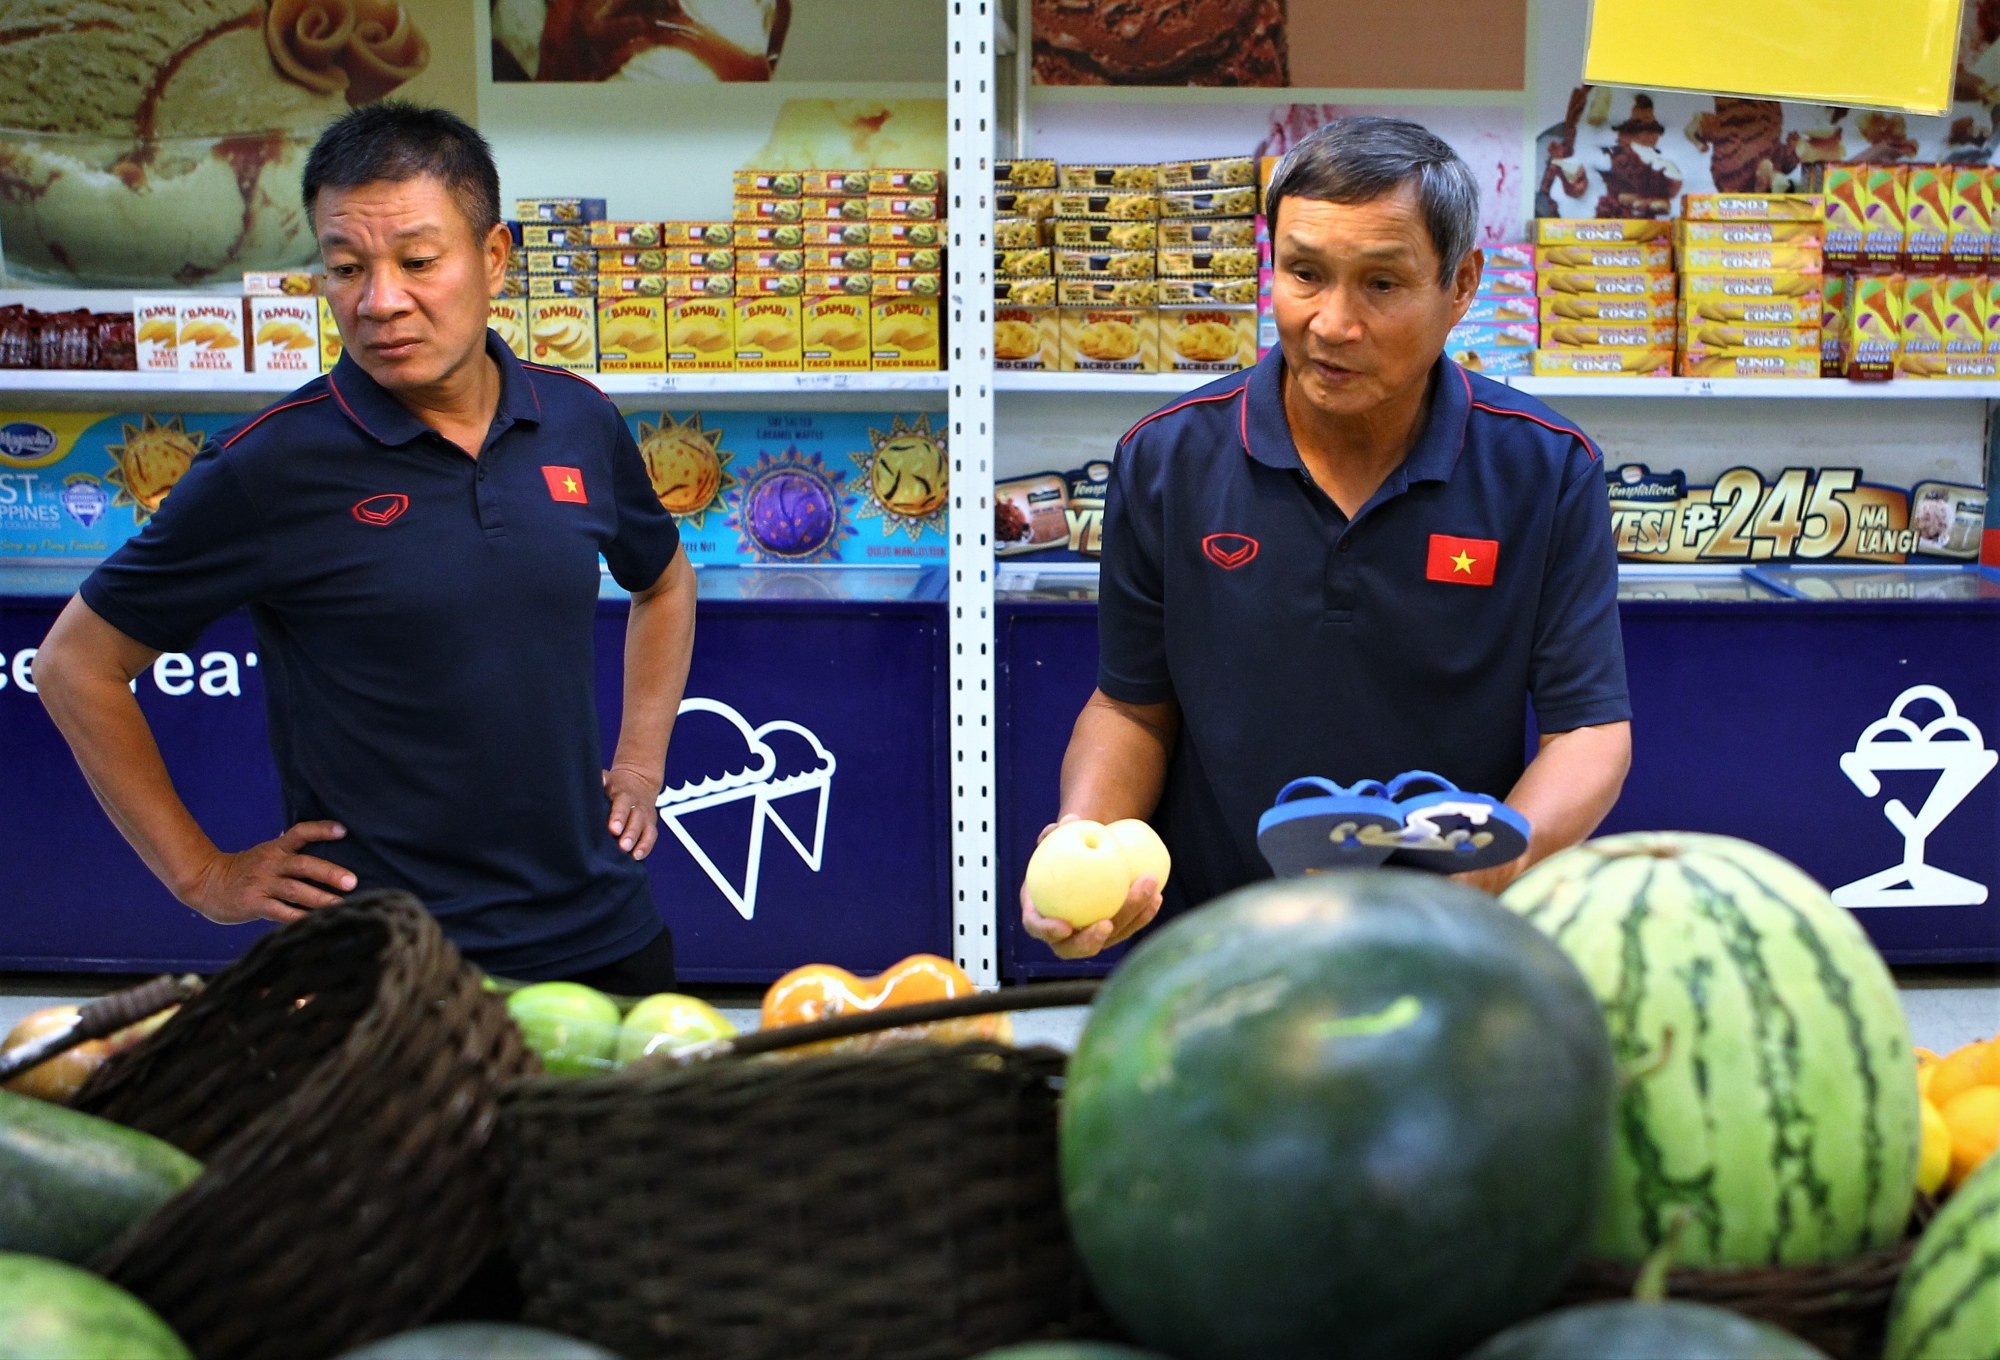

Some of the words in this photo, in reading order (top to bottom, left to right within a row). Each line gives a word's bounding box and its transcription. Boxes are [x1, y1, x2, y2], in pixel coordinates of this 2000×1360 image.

[1576, 229, 1624, 241] CONES
[1723, 231, 1773, 243] CONES
[1591, 255, 1642, 266] CONES
[1722, 257, 1772, 268] CONES
[1595, 282, 1645, 293] CONES
[1723, 284, 1773, 295] CONES
[144, 306, 176, 318] BAM
[187, 306, 230, 319] BAMBI
[263, 306, 305, 319] BAMBI
[490, 306, 515, 320] MBI
[539, 306, 583, 319] BAMBI
[611, 305, 651, 319] BAMBI
[680, 305, 720, 318] BAMBI
[748, 304, 788, 317] BAMBI
[816, 303, 856, 317] BAMBI
[884, 303, 925, 317] BAMBI
[1598, 308, 1648, 319] CONES
[1743, 310, 1793, 321] CONES
[994, 310, 1033, 324] AMBI
[1184, 310, 1232, 325] BAMBI
[1598, 334, 1647, 345] CONES
[1743, 336, 1792, 347] CONES
[153, 351, 177, 360] TAC
[195, 352, 226, 360] TACO
[272, 352, 302, 360] TACO
[148, 360, 177, 369] SHEL
[190, 361, 233, 370] SHELLS
[267, 361, 308, 370] SHELLS
[671, 361, 696, 369] TACO
[698, 361, 732, 369] SHELLS
[765, 360, 799, 368] SHELLS
[1014, 361, 1046, 369] CHIPS
[1074, 362, 1111, 370] NACHO
[1113, 362, 1145, 370] CHIPS
[1172, 362, 1210, 371] NACHO
[1211, 362, 1243, 371] CHIPS
[1572, 360, 1622, 371] CONES
[1946, 364, 1996, 375] CONES
[1607, 482, 1678, 498] Temptations
[1858, 505, 1888, 528] NA
[1857, 528, 1920, 553] LANG!
